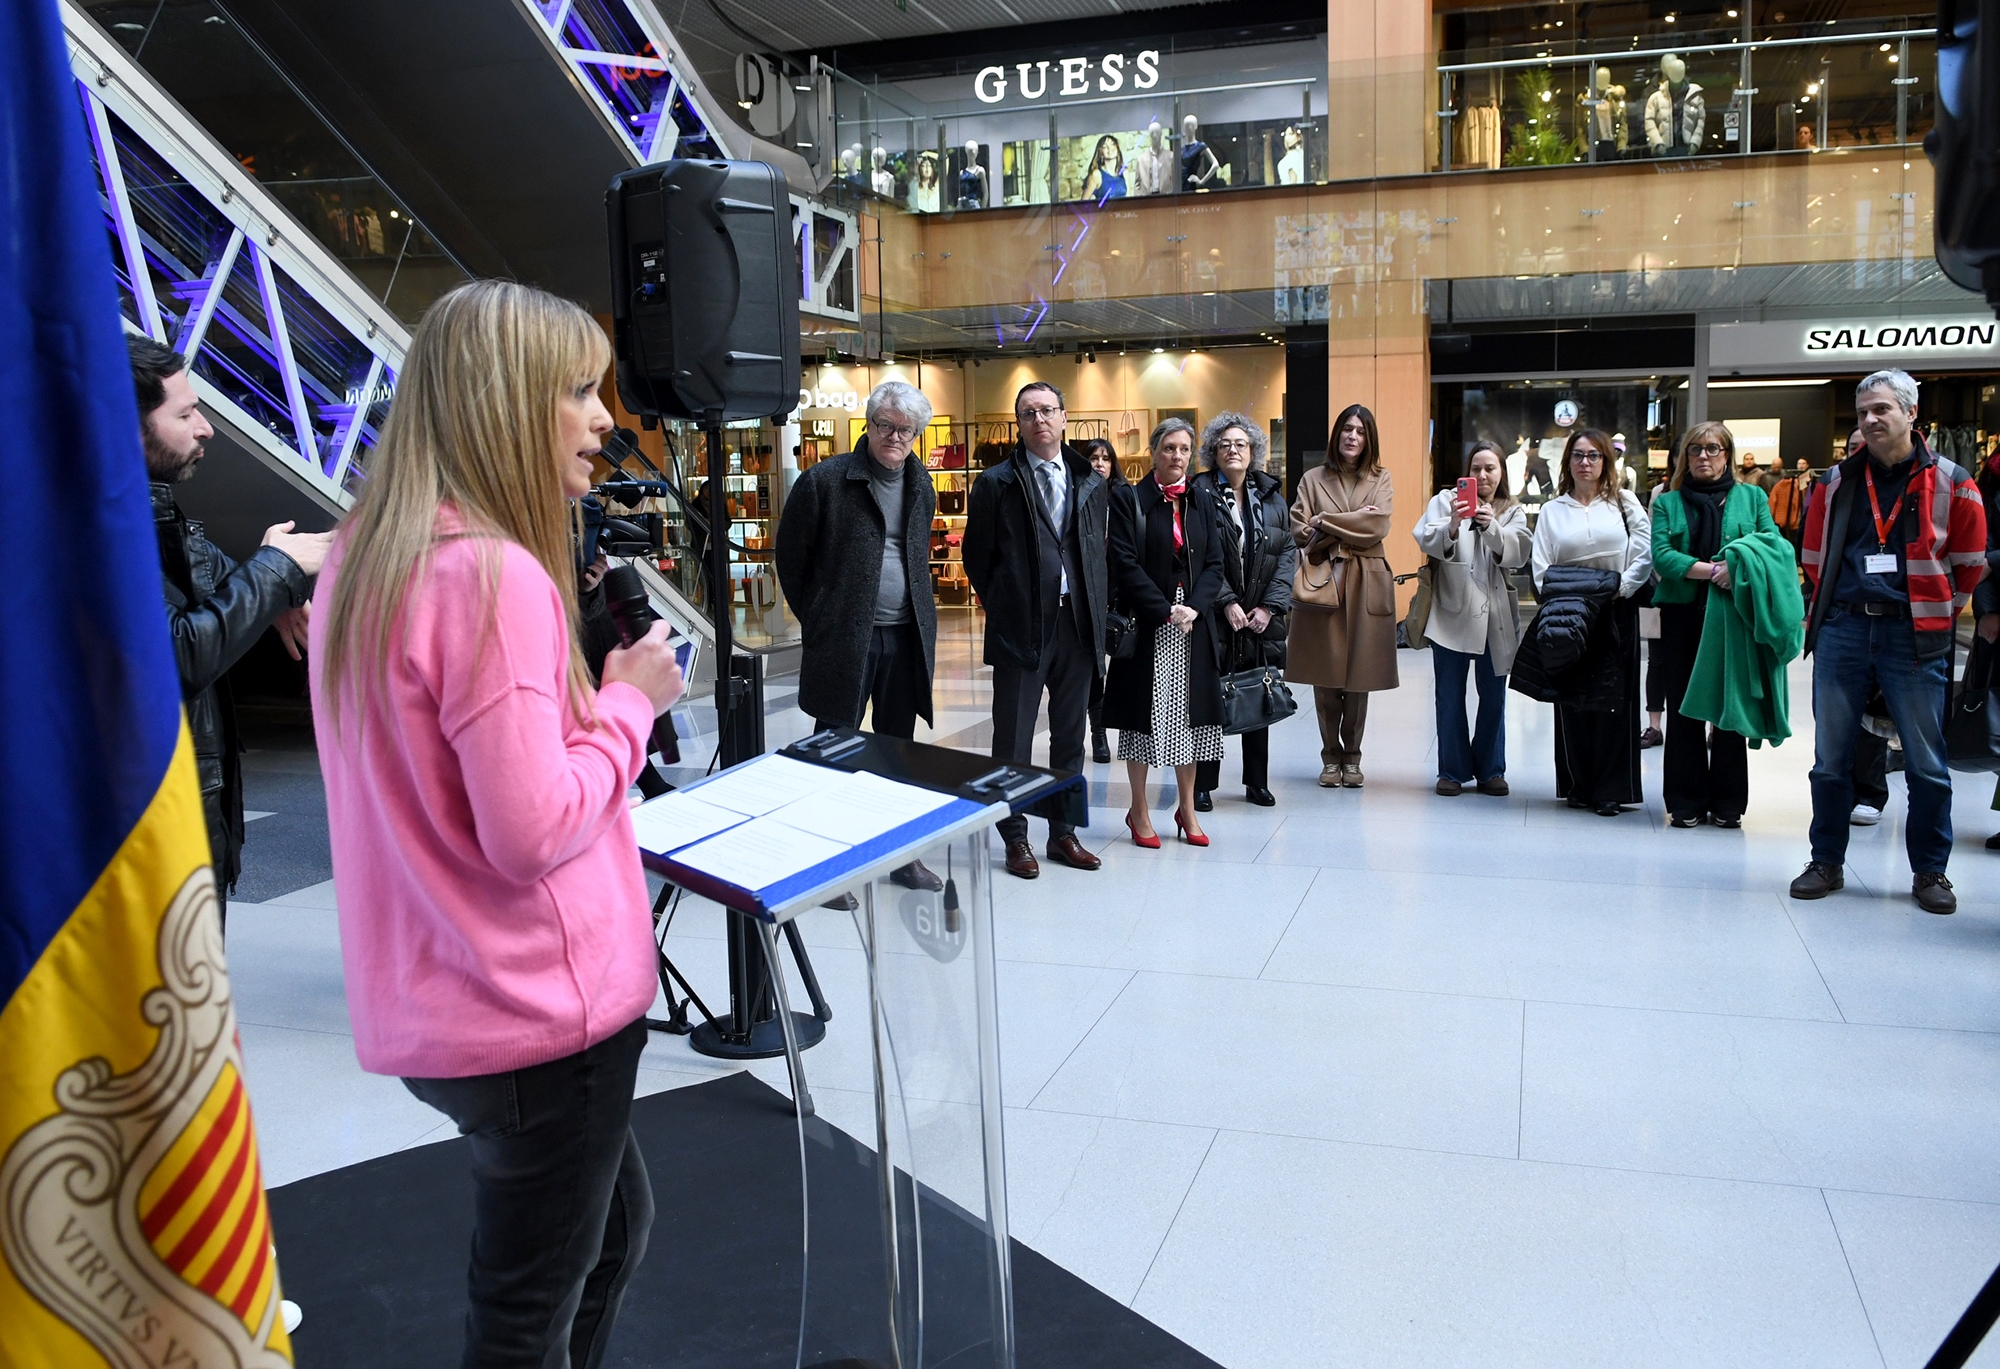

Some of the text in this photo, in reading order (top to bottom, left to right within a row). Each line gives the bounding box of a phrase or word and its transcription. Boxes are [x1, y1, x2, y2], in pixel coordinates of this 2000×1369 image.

[974, 50, 1159, 103] GUESS
[1807, 324, 1995, 350] SALOMON
[815, 387, 858, 413] bag
[55, 1214, 162, 1343] VIRTVS
